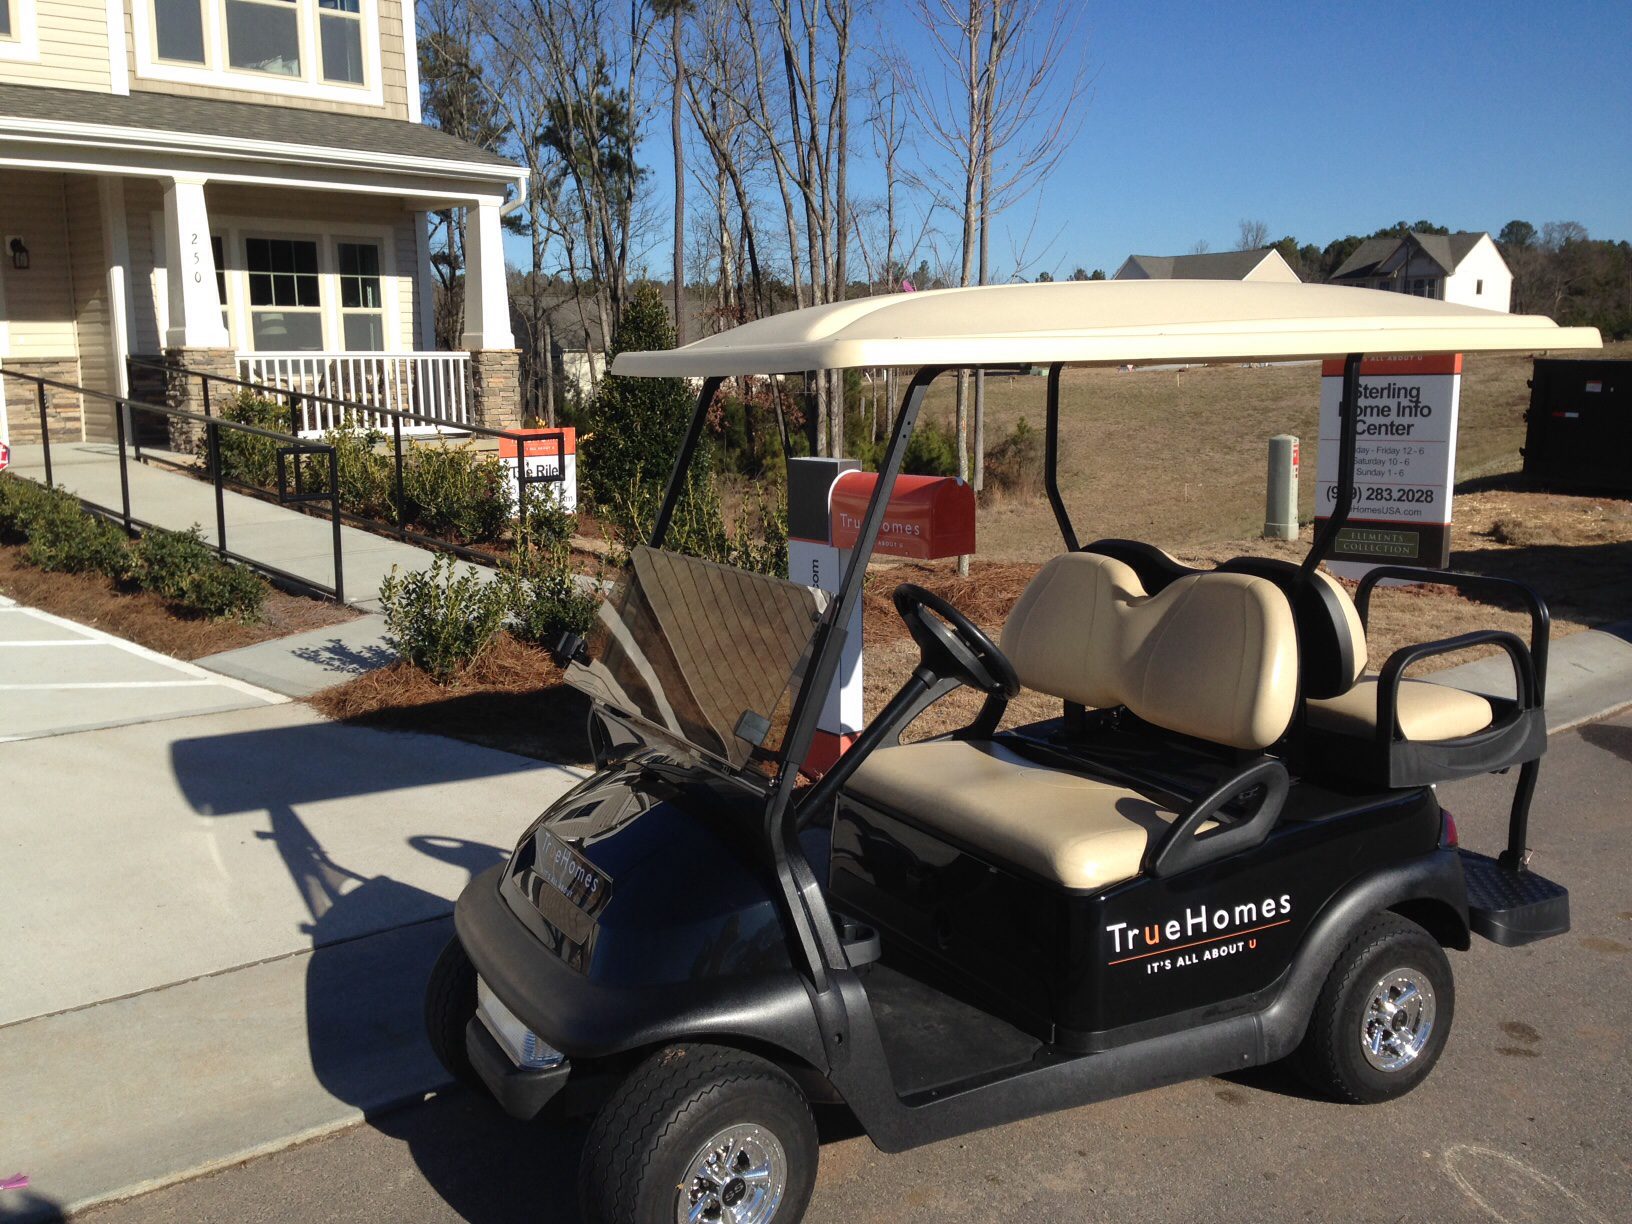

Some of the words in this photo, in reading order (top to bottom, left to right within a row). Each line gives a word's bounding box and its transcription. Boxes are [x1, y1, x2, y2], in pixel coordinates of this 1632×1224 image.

[191, 233, 202, 284] 250
[1357, 383, 1421, 403] Sterling
[1397, 401, 1432, 418] Info
[1356, 419, 1415, 436] Center
[1376, 447, 1400, 456] Friday
[1403, 447, 1413, 455] 12
[1418, 447, 1425, 455] 6
[1355, 457, 1385, 466] Saturday
[510, 466, 533, 479] Te
[536, 464, 559, 477] Rile
[1356, 468, 1385, 477] Sunday
[1398, 469, 1405, 477] 6
[1326, 486, 1362, 503] (99)
[1365, 487, 1434, 503] 283.2028
[1351, 505, 1422, 516] HomesUSA.com
[840, 513, 920, 535] Truomes
[1343, 543, 1410, 553] COLLECTION
[543, 832, 598, 892] TrueHomes
[1106, 894, 1292, 953] TrueHomes
[1147, 959, 1172, 974] IT'S
[1176, 952, 1199, 967] ALL
[1203, 942, 1244, 961] ABOUT
[1249, 939, 1257, 949] U
